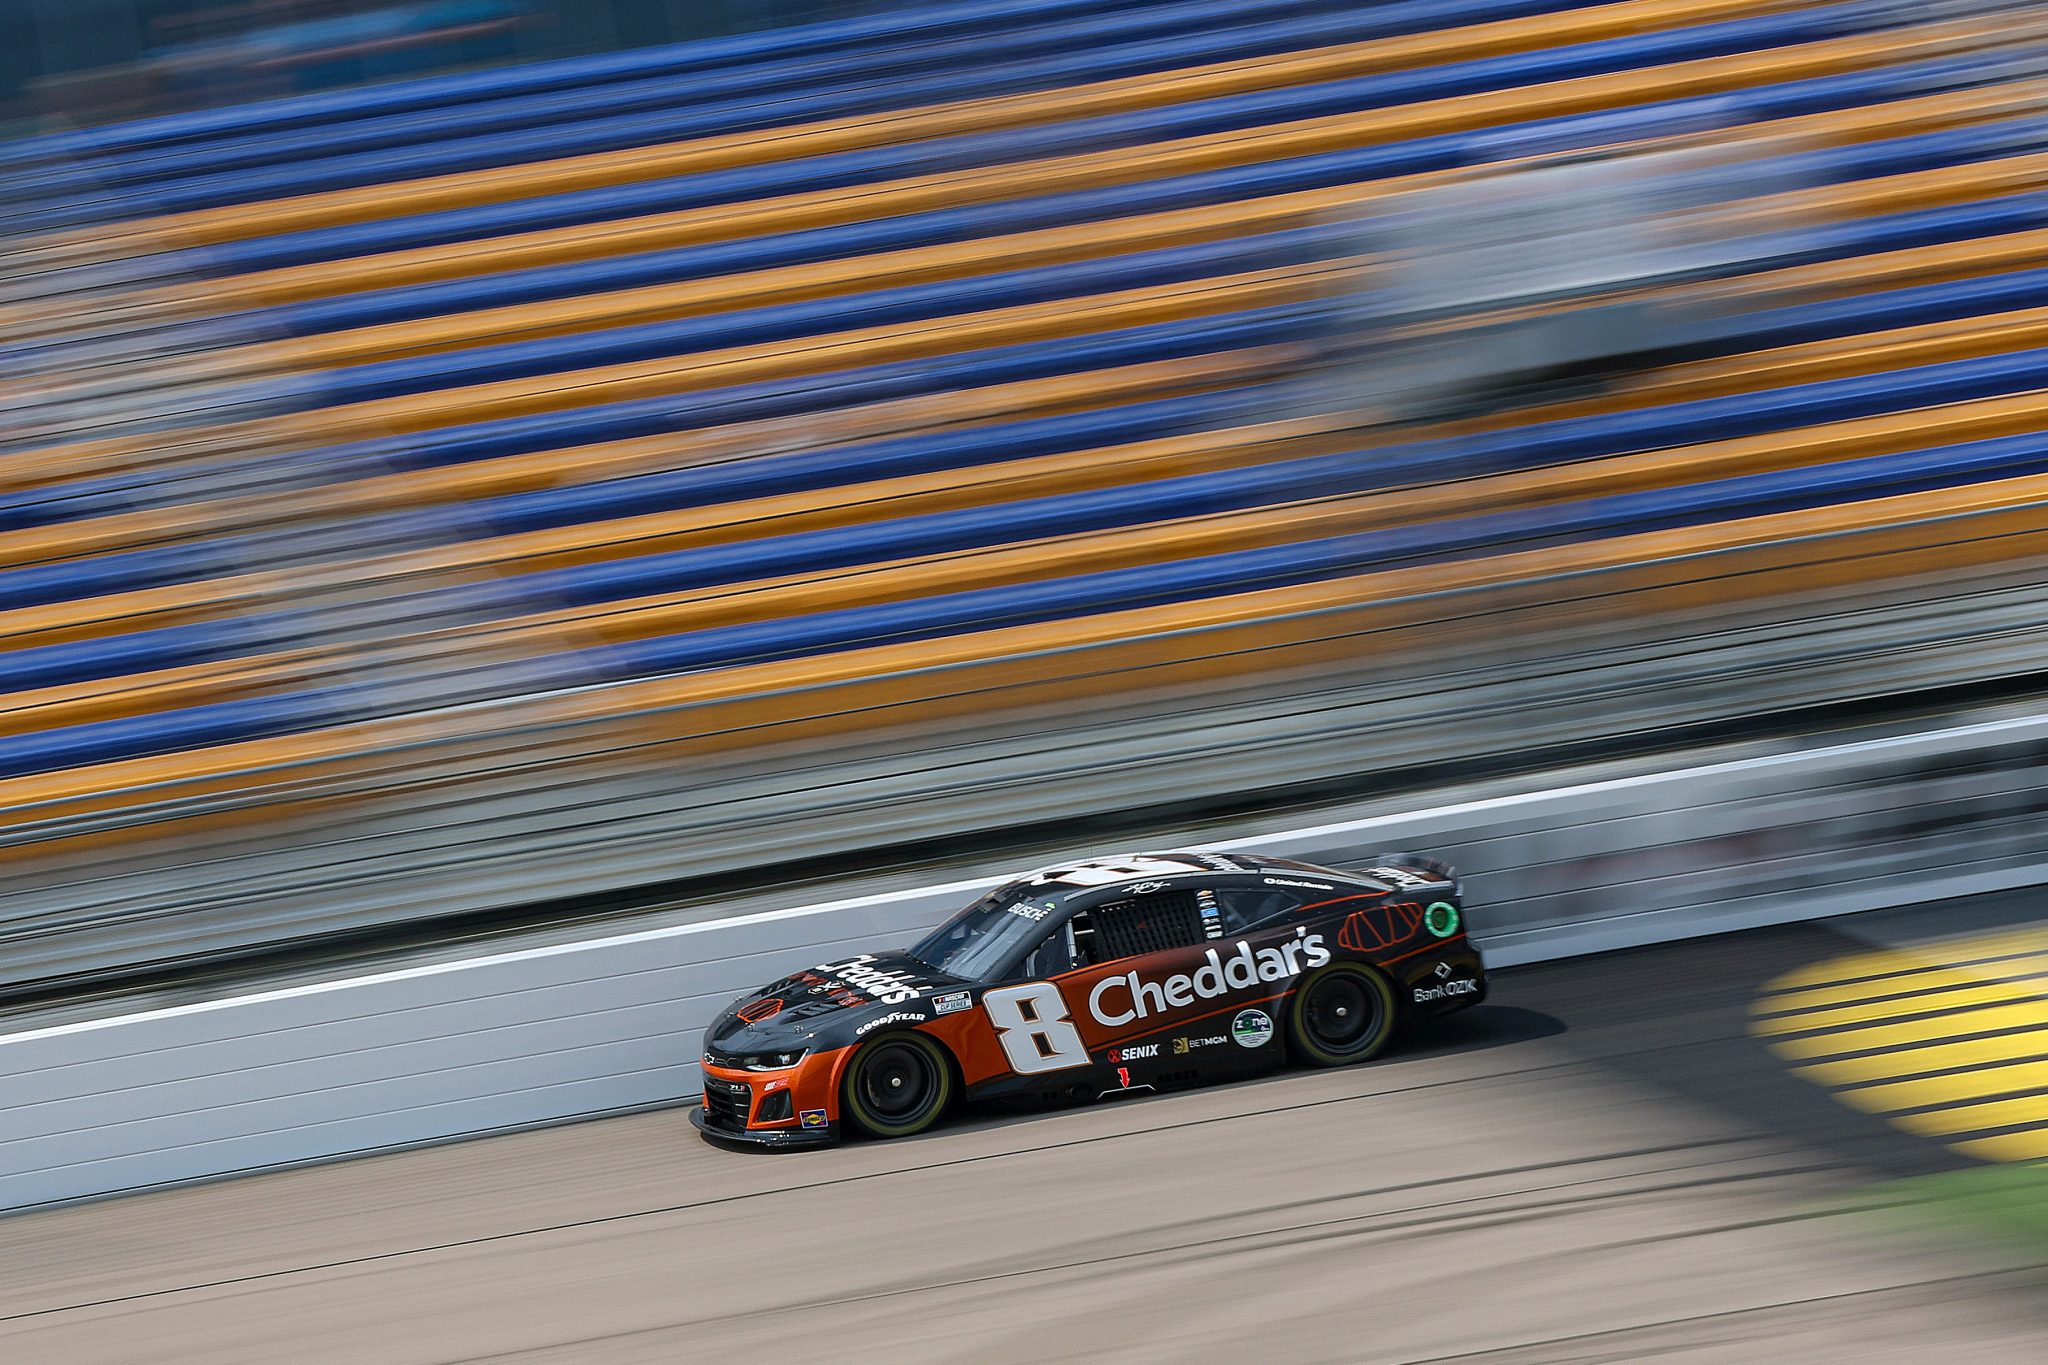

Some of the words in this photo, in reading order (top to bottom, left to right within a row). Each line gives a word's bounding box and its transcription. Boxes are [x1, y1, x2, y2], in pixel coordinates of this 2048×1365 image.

[1089, 925, 1332, 1027] Cheddar's
[856, 1012, 926, 1035] GOODYEAR
[982, 981, 1093, 1075] 8
[1121, 1044, 1159, 1061] SENIX
[1189, 1035, 1228, 1049] BETMGM
